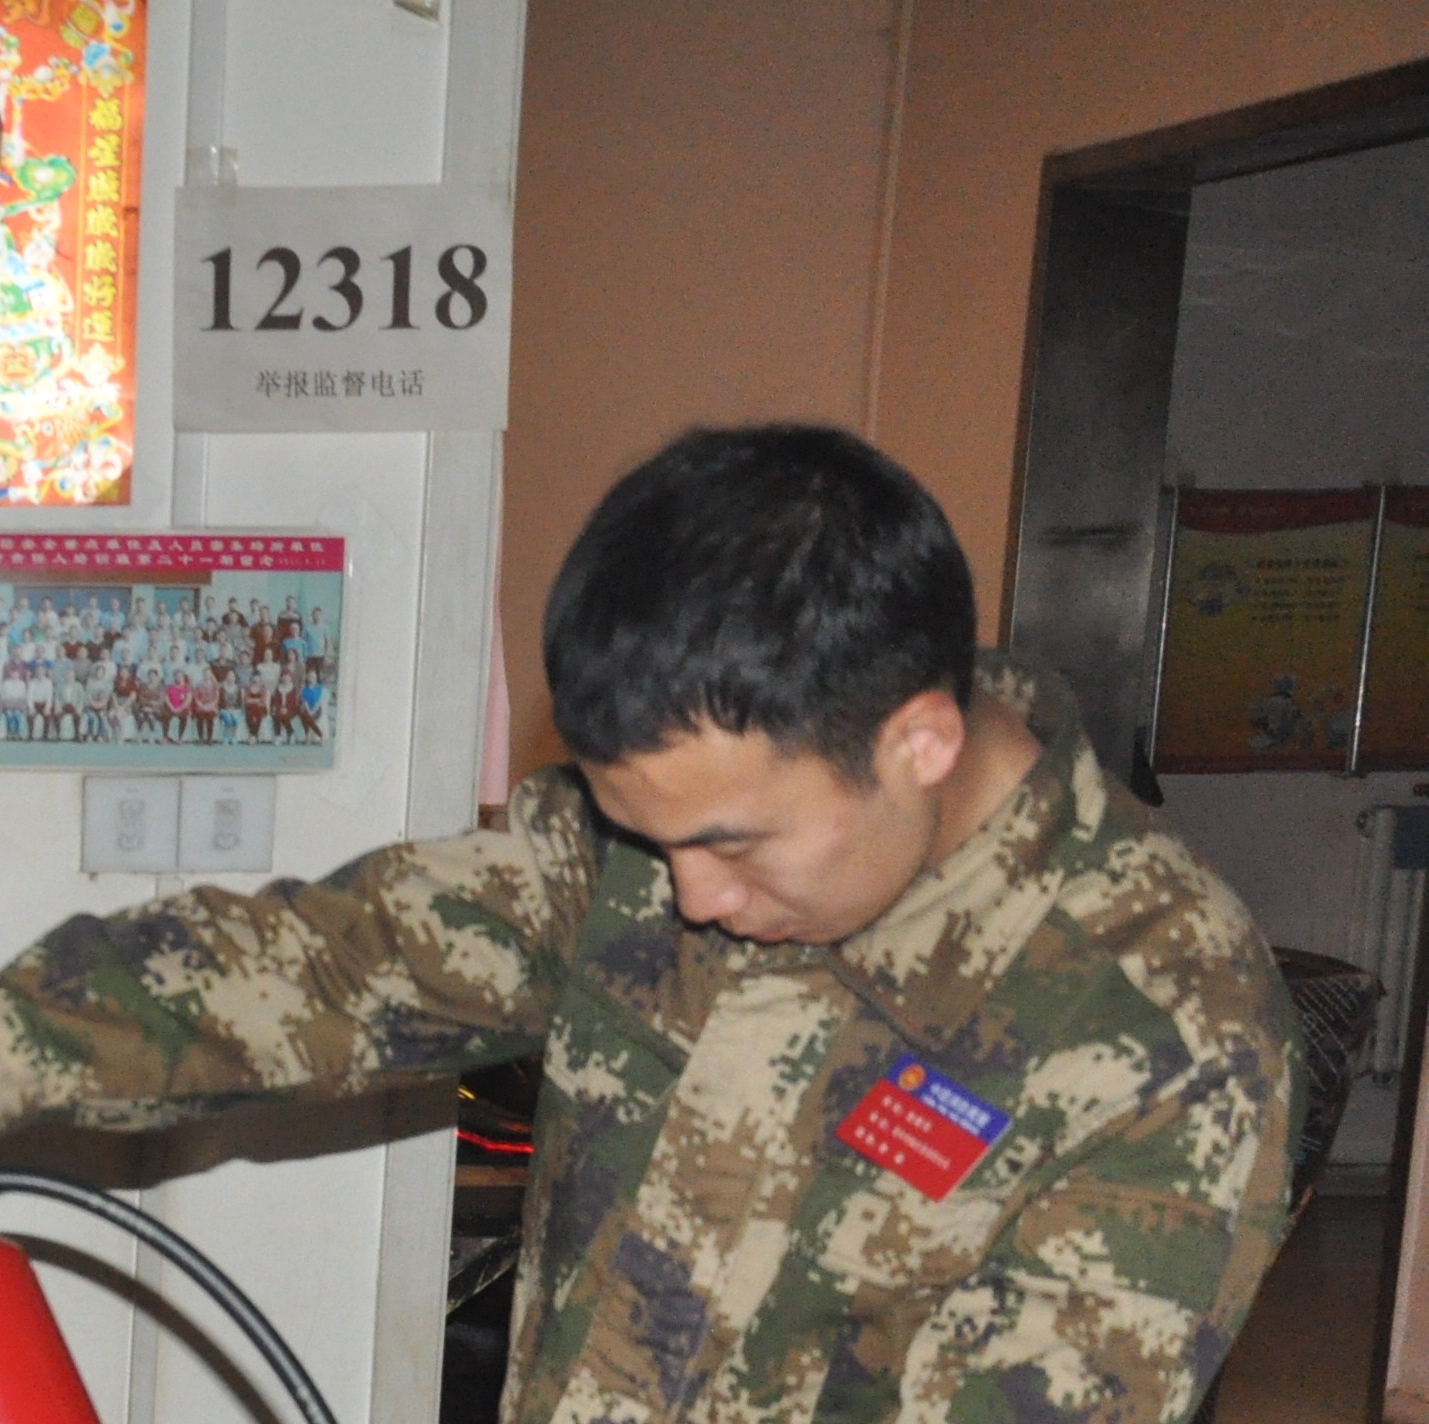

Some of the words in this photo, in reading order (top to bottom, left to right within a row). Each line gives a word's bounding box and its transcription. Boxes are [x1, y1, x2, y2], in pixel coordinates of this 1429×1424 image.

[199, 243, 489, 332] 12318
[255, 368, 425, 398] 举报监督电话
